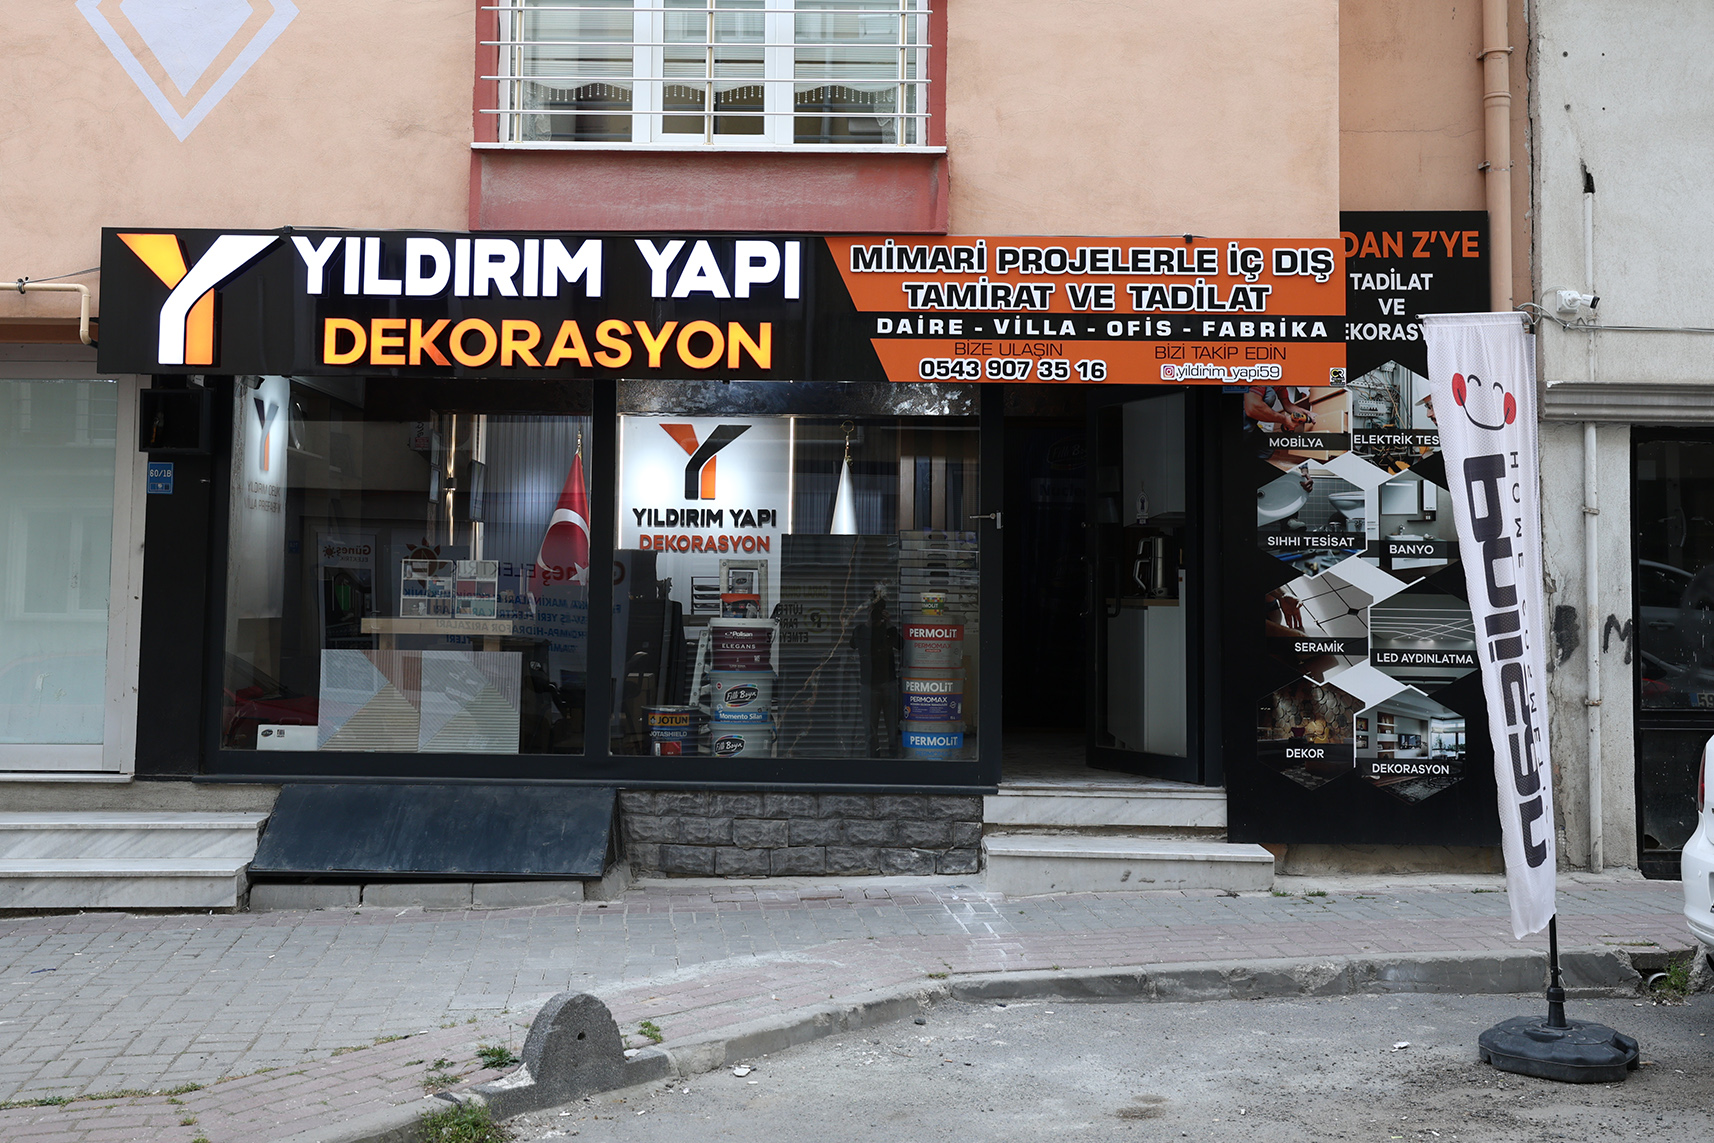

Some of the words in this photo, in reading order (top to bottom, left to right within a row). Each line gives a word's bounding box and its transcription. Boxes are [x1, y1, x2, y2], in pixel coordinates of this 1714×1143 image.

[1412, 231, 1479, 258] Z'YE
[290, 236, 603, 297] YILDIRIM
[634, 239, 800, 299] YAPI
[850, 239, 987, 273] MİMARİ
[996, 246, 1218, 275] PROJELERLE
[1227, 242, 1263, 282] İÇ
[1273, 248, 1334, 283] DIŞ
[1350, 268, 1433, 290] TADİLAT
[902, 276, 1055, 310] TAMİRAT
[1065, 283, 1115, 310] VE
[1126, 278, 1272, 312] TADİLAT
[1378, 298, 1405, 316] VE
[877, 315, 964, 335] DAİRE
[993, 315, 1076, 335] VİLLA
[1106, 317, 1172, 337] OFİS
[1202, 318, 1328, 338] FABRİKA
[323, 318, 772, 370] DEKORASYON
[954, 339, 993, 356] BİZE
[999, 342, 1063, 359] ULAŞIN
[1155, 343, 1185, 359] BİZİ
[1191, 343, 1238, 360] TAKİP
[1245, 344, 1286, 360] EDİN
[919, 358, 982, 379] 0543
[986, 359, 1033, 380] 907
[1037, 360, 1070, 380] 35
[1075, 361, 1108, 381] 16
[1269, 435, 1324, 447] MOBİLYA
[1354, 432, 1412, 445] ELEKTRİK
[632, 508, 723, 528] YILDIRIM
[729, 509, 777, 528] YAPI
[639, 534, 770, 554] DEKORASYON
[1304, 535, 1355, 547] TESİSAT
[1389, 544, 1434, 555] BANYO
[1294, 640, 1345, 653] SERAMİK
[1377, 653, 1399, 663] LED
[1401, 653, 1474, 665] AYDINLATMA
[658, 716, 688, 725] JOTUN
[1286, 748, 1324, 759] DEKOR
[1372, 763, 1450, 776] DEKORASYON
